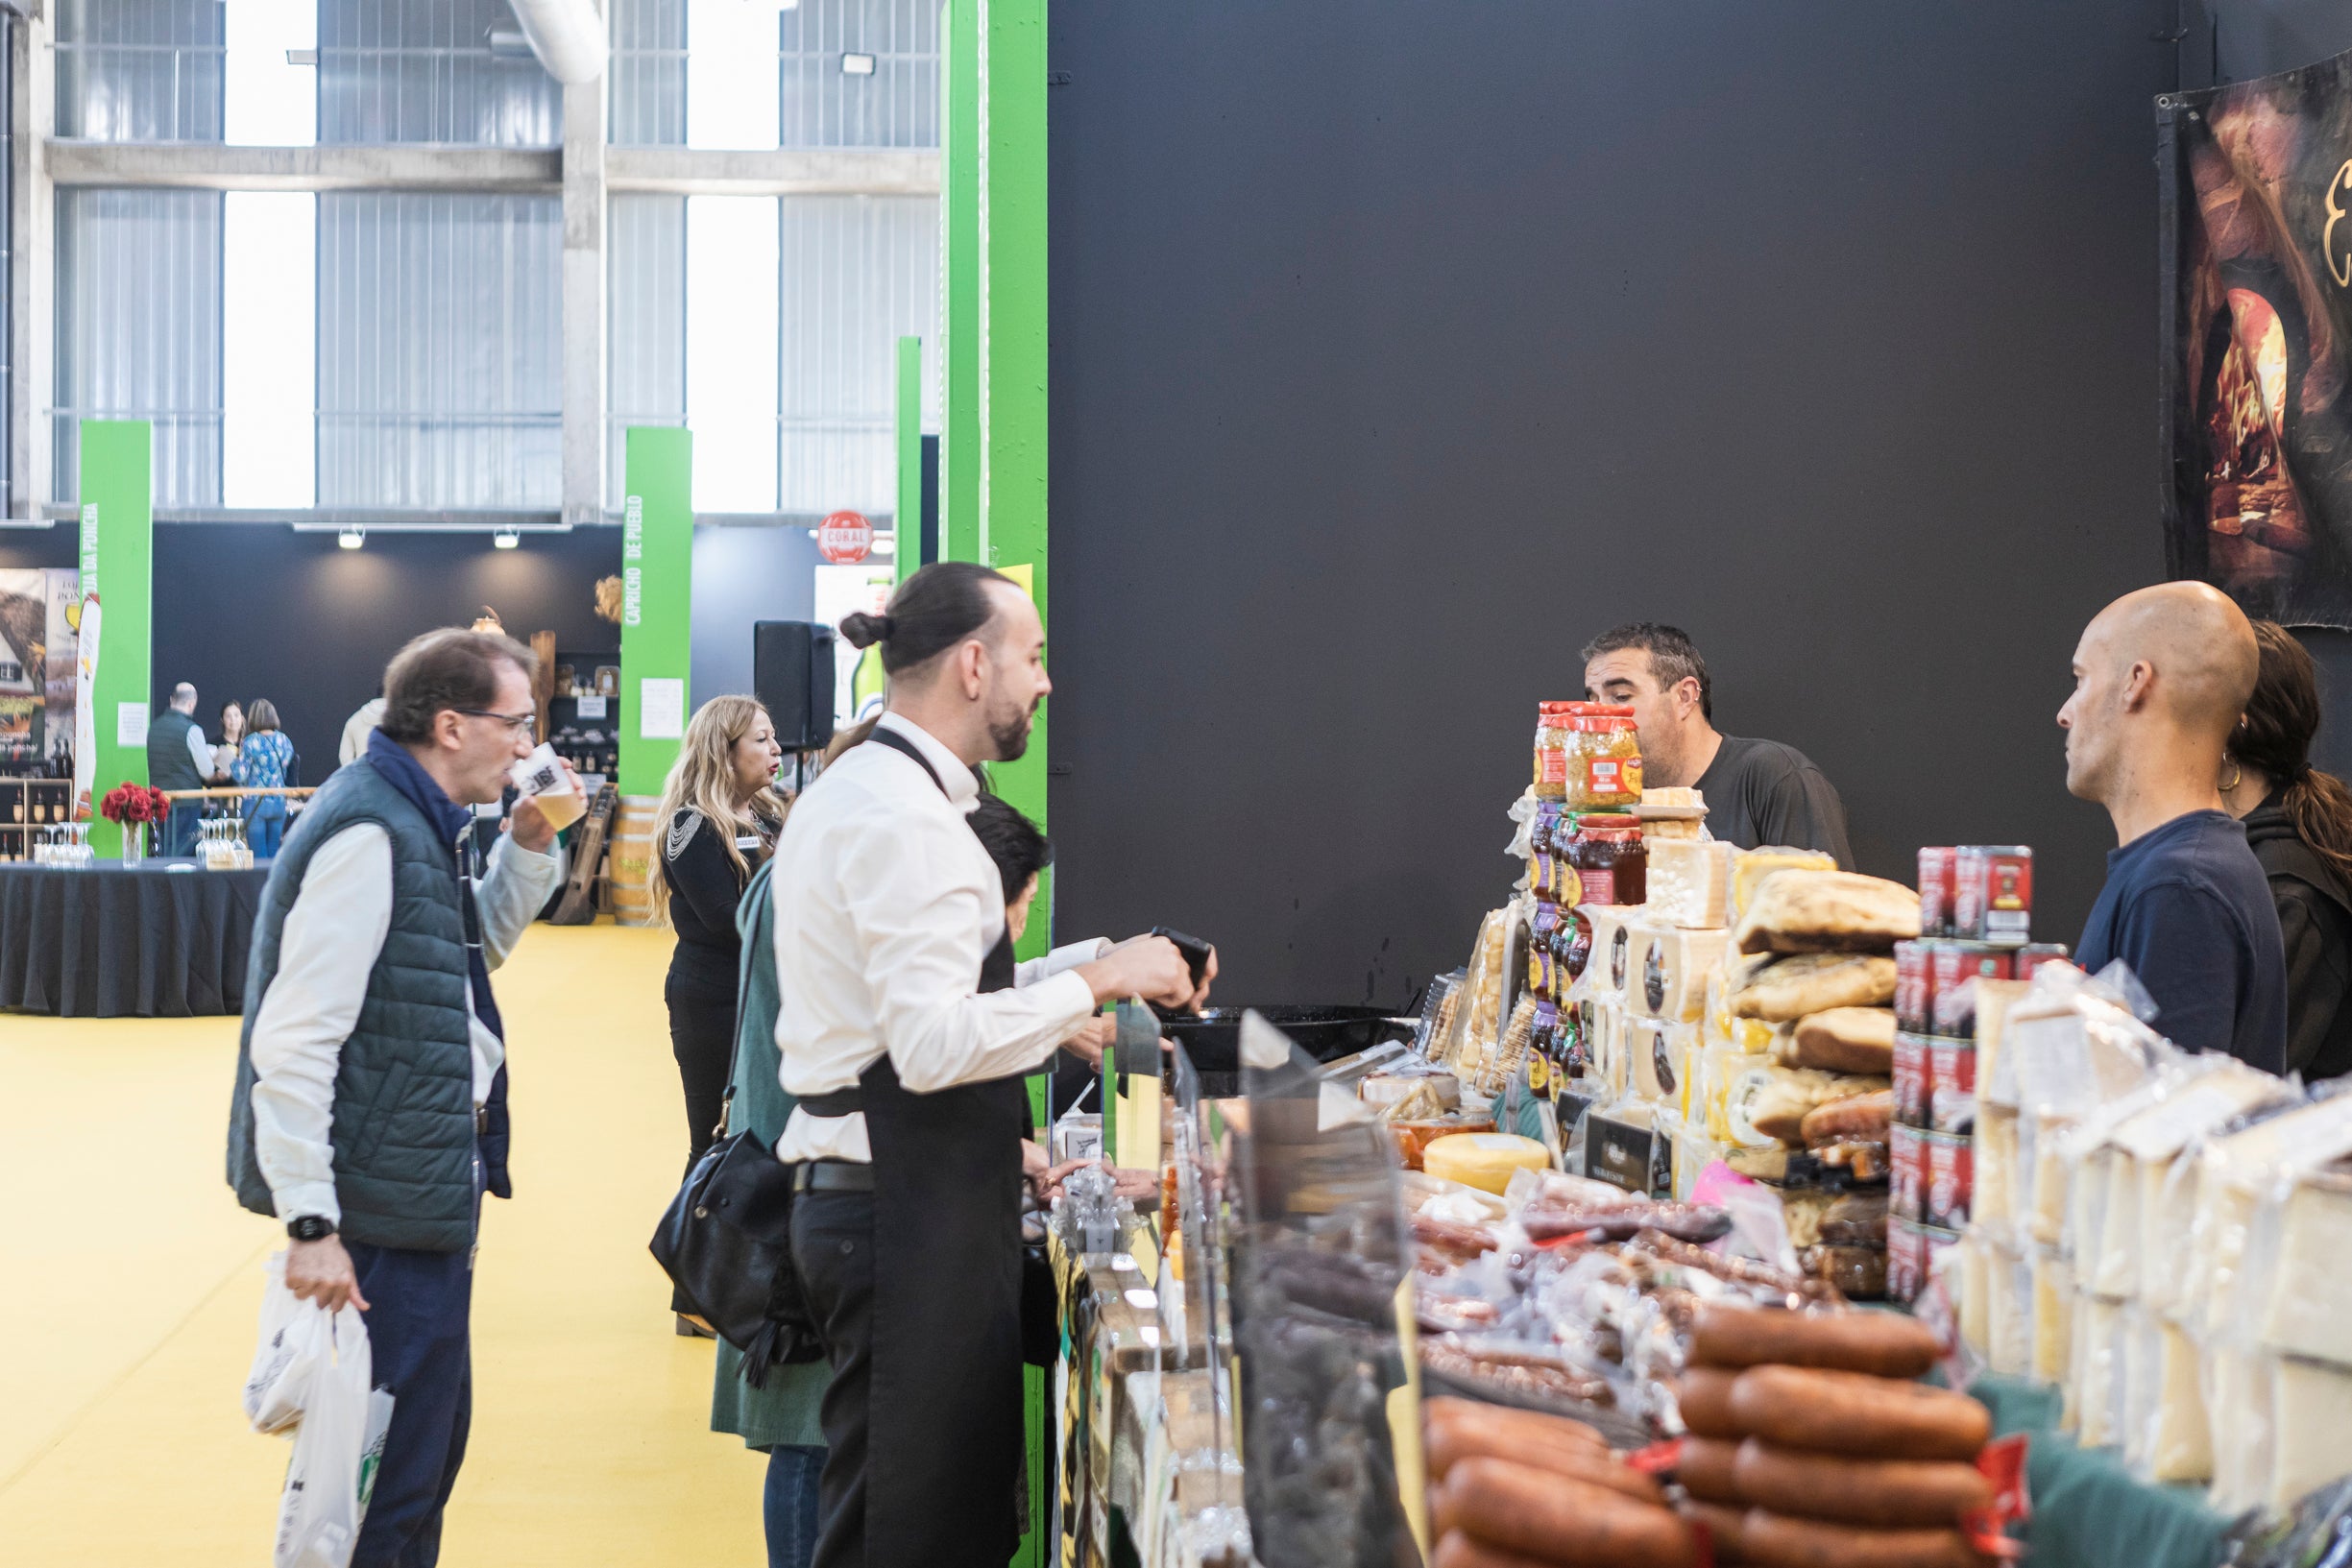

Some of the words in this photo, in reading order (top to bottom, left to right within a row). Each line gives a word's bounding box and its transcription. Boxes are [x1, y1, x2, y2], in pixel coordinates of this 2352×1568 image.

[83, 503, 98, 551] PONCHA
[626, 495, 642, 540] PUEBLO
[626, 541, 642, 559] DE
[828, 530, 863, 543] CORAL
[83, 553, 97, 571] DA
[625, 567, 641, 625] CAPRICHO
